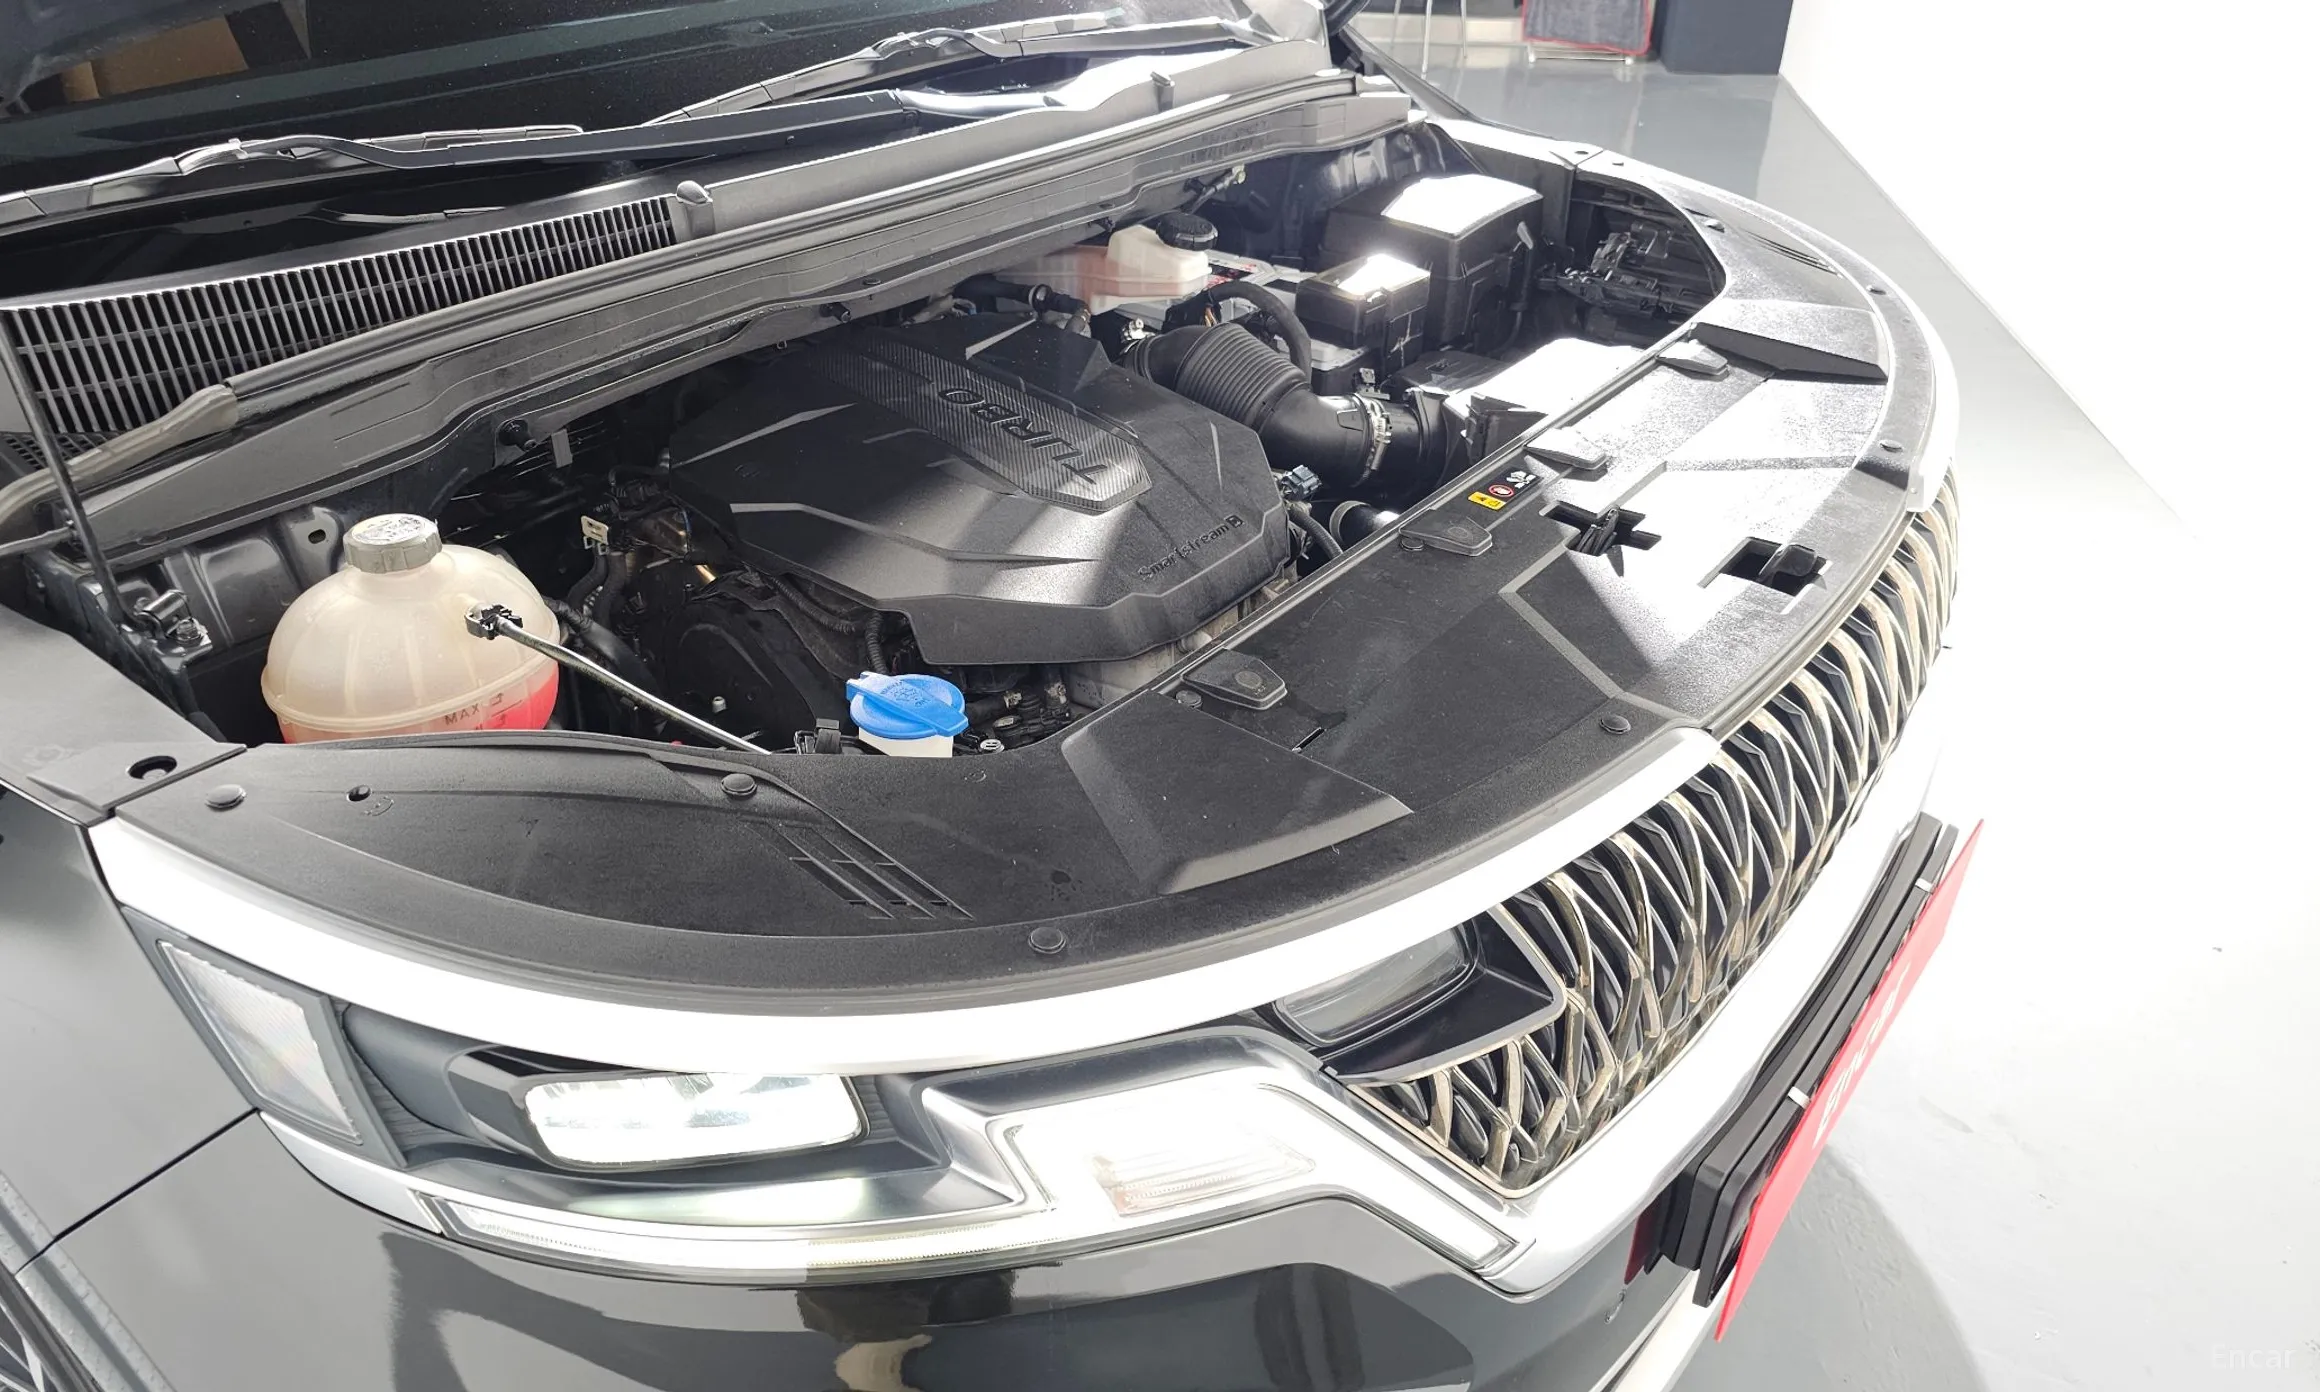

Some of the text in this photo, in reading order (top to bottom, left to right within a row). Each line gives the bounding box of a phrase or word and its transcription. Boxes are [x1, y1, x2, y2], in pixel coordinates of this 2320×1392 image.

[938, 388, 1108, 485] TURBO
[1138, 523, 1230, 580] Smartstream
[444, 703, 480, 726] MAX
